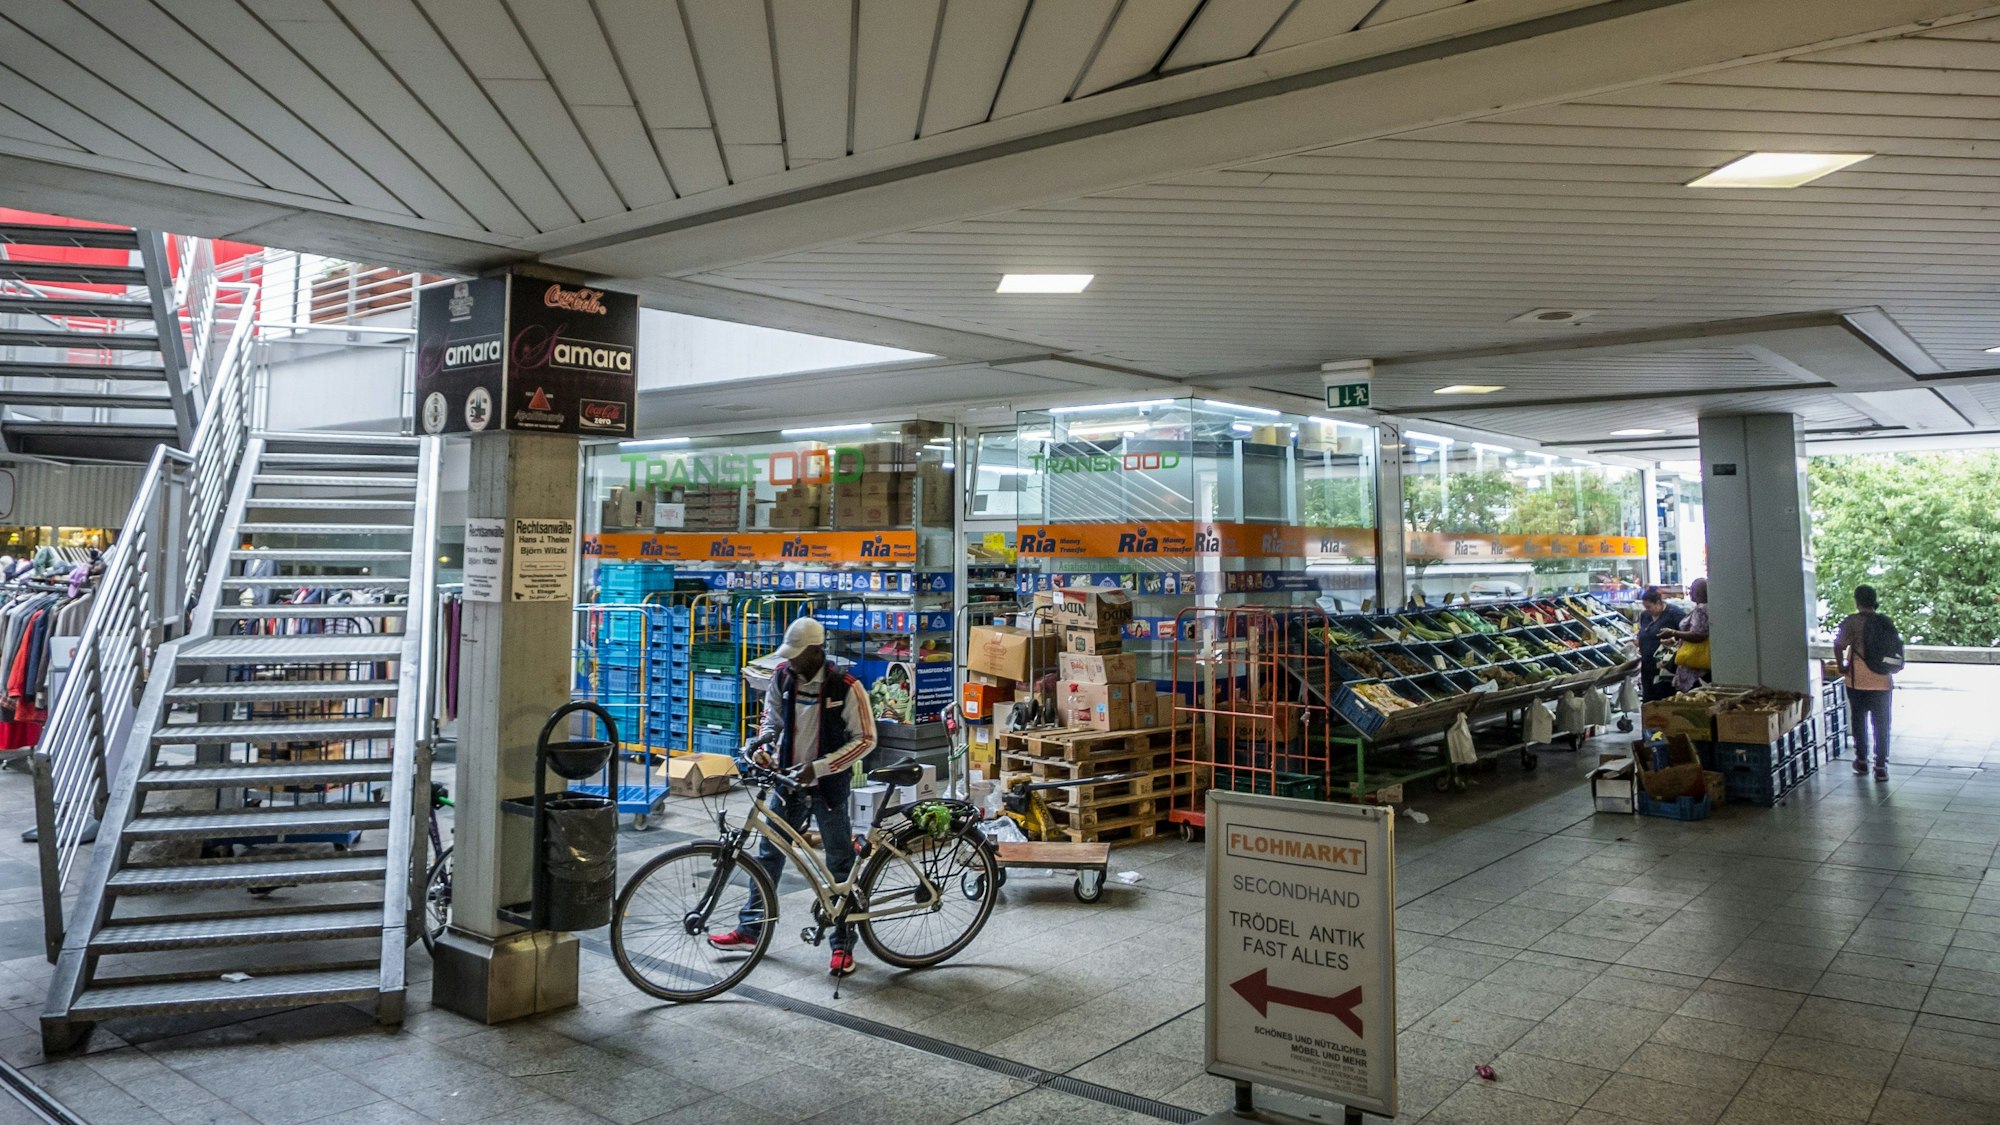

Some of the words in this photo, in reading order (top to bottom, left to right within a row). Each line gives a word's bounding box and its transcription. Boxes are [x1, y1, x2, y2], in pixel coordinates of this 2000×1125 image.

[544, 284, 603, 315] Coca-Cola
[594, 417, 612, 425] zero
[516, 520, 572, 534] Rechtsanwälte
[582, 538, 602, 555] Ria
[640, 537, 662, 556] Ria
[710, 537, 735, 557] Ria
[781, 536, 809, 557] Ria
[860, 535, 891, 557] Ria
[1020, 527, 1056, 553] Ria
[1118, 526, 1158, 553] Ria
[1162, 537, 1186, 545] Money
[1195, 525, 1220, 552] Ria
[1320, 538, 1340, 553] Ria
[1455, 540, 1469, 555] Ria
[521, 547, 542, 556] Björn
[1230, 833, 1362, 866] FLOHMARKT
[1233, 874, 1360, 909] SECONDHAND
[1229, 910, 1300, 938] TRÖDEL
[1309, 925, 1365, 949] ANTIK
[1243, 936, 1288, 959] FAST
[1291, 946, 1349, 971] ALLES
[1254, 1026, 1293, 1041] SCHÖNES
[1295, 1034, 1313, 1045] UND
[1314, 1038, 1367, 1057] NÜTZLICHES
[1291, 1043, 1320, 1058] MÖBEL
[1323, 1051, 1340, 1062] UND
[1342, 1055, 1367, 1068] MEHR
